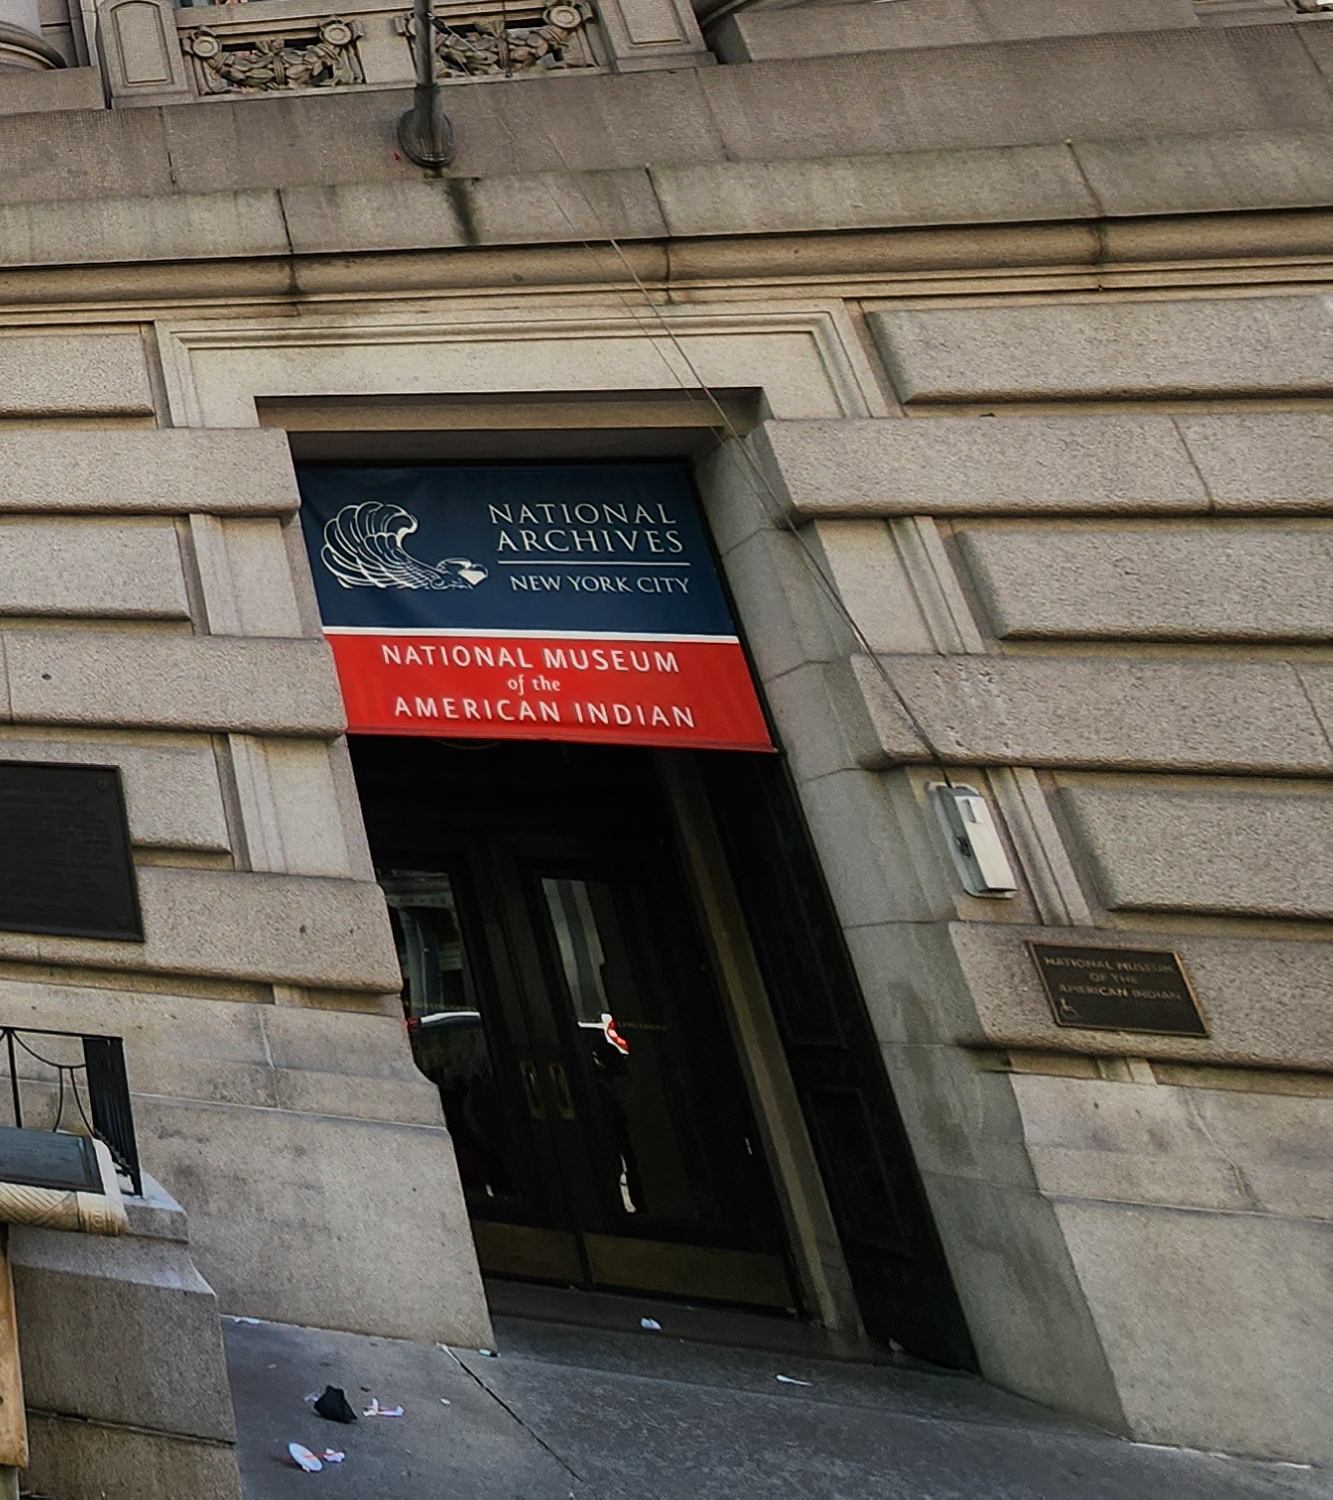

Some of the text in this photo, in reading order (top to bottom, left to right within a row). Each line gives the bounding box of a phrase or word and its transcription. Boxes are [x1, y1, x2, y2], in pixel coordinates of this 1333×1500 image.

[488, 502, 676, 525] NATIONAL
[496, 530, 684, 553] ARCHIVES
[509, 575, 691, 594] NEW YORK CITY
[381, 645, 680, 673] NATIONAL MUSEUM
[507, 674, 561, 696] of the
[394, 696, 696, 728] AMERICAN INDIAN
[1044, 956, 1175, 974] NATIONAL MUSEUM
[1089, 972, 1138, 985] OF THE
[1058, 983, 1182, 1000] AMERICAN INDIAN
